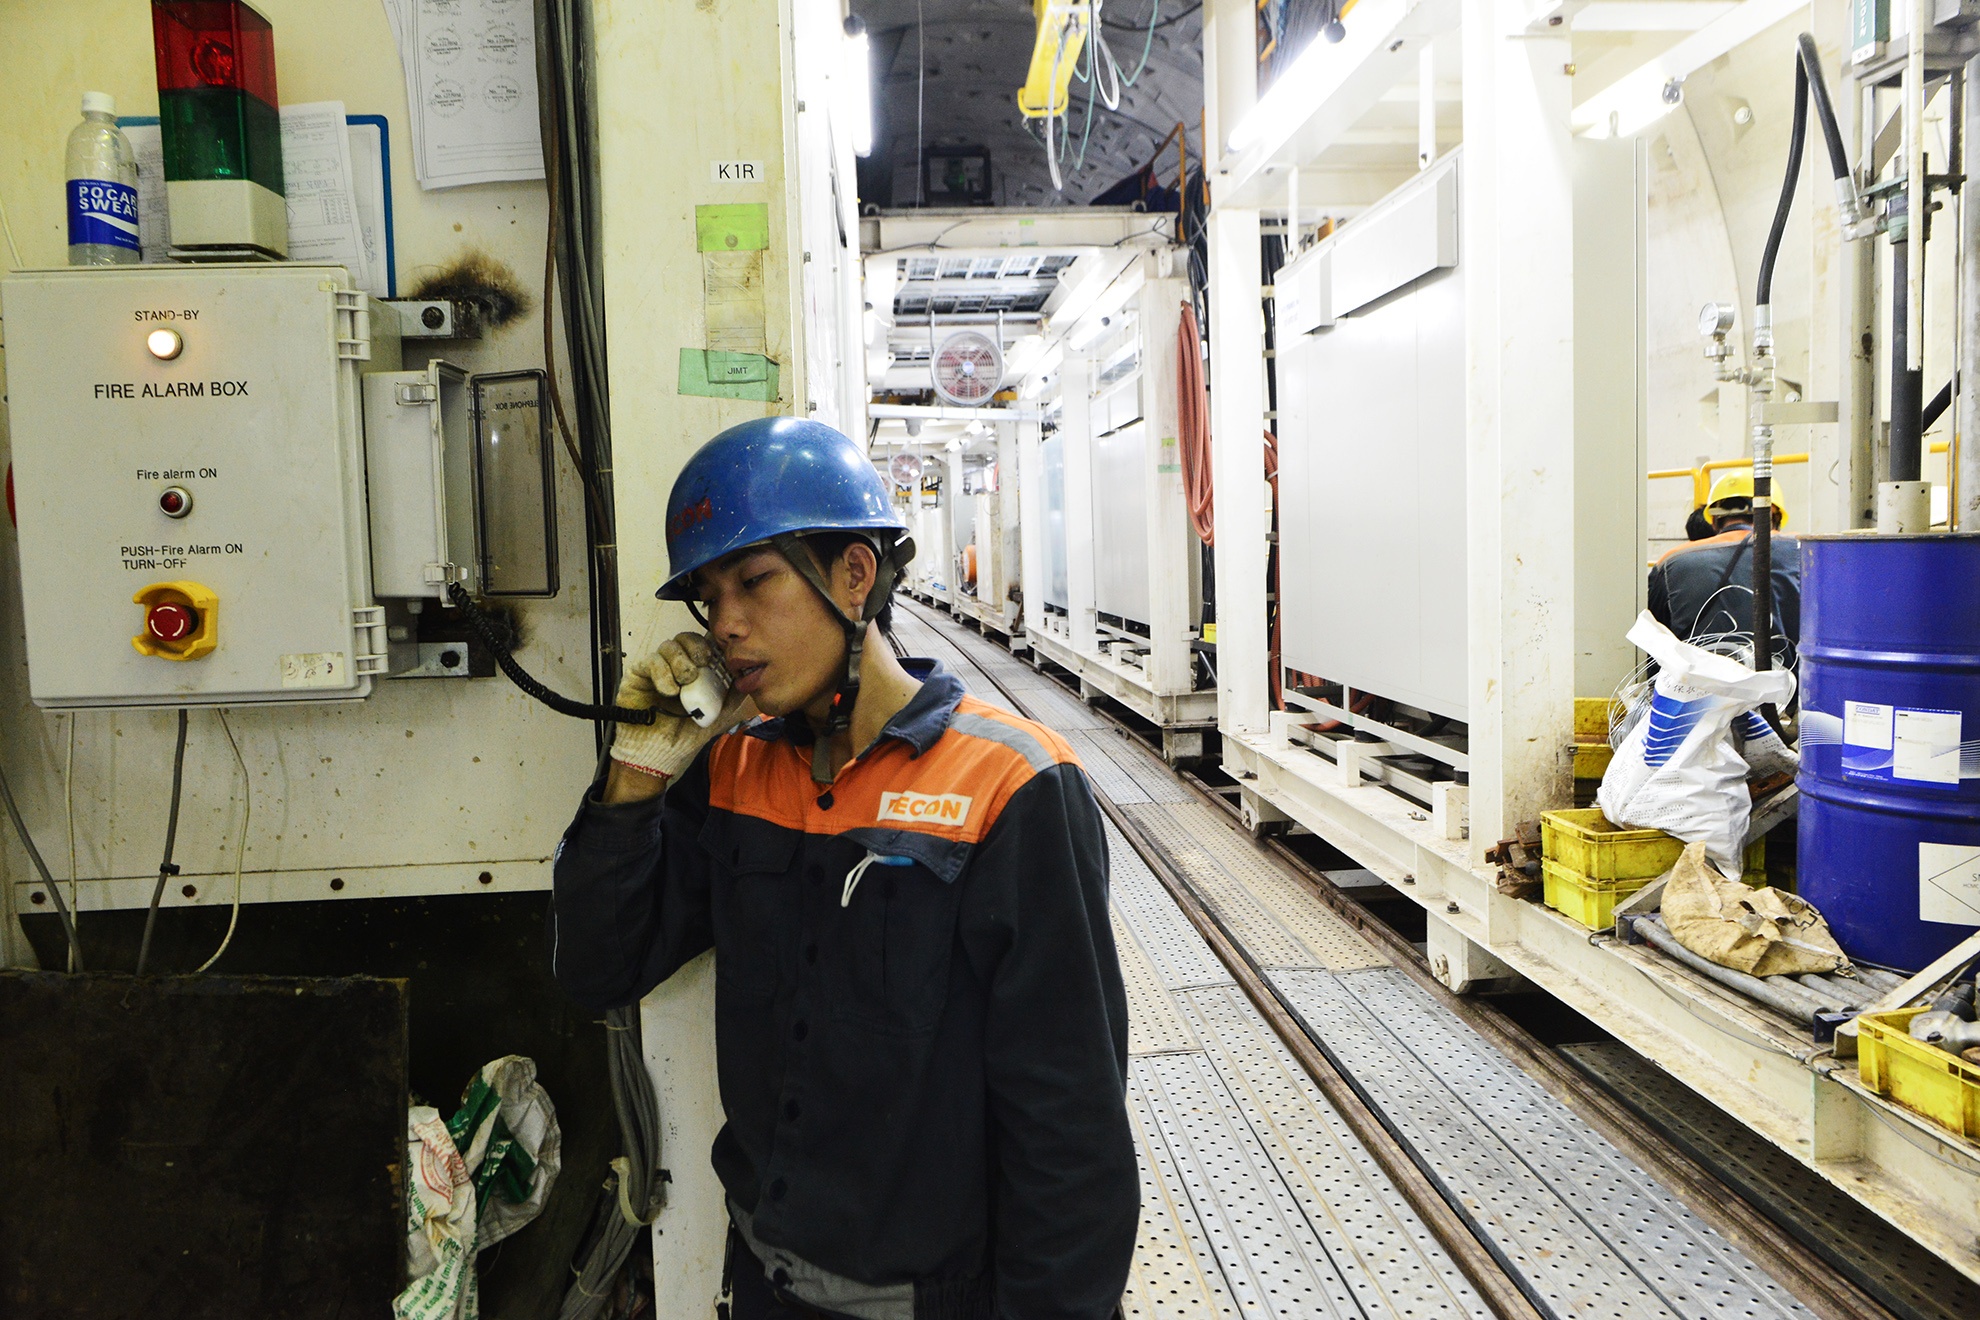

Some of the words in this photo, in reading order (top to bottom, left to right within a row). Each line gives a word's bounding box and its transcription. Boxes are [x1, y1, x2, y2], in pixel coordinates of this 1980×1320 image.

[719, 164, 754, 179] K1R
[79, 198, 138, 218] SWEAT
[135, 310, 200, 322] STAND-BY
[727, 367, 749, 375] JIMT
[94, 383, 135, 399] FIRE
[142, 382, 204, 398] ALARM
[211, 381, 249, 396] BOX
[137, 469, 159, 480] Fire
[163, 469, 195, 480] alarm
[199, 468, 217, 479] ON
[121, 545, 184, 556] PUSH-Fire
[188, 544, 221, 555] Alarm
[225, 543, 243, 554] ON
[122, 558, 187, 570] TURN-OFF
[1972, 873, 1980, 882] S
